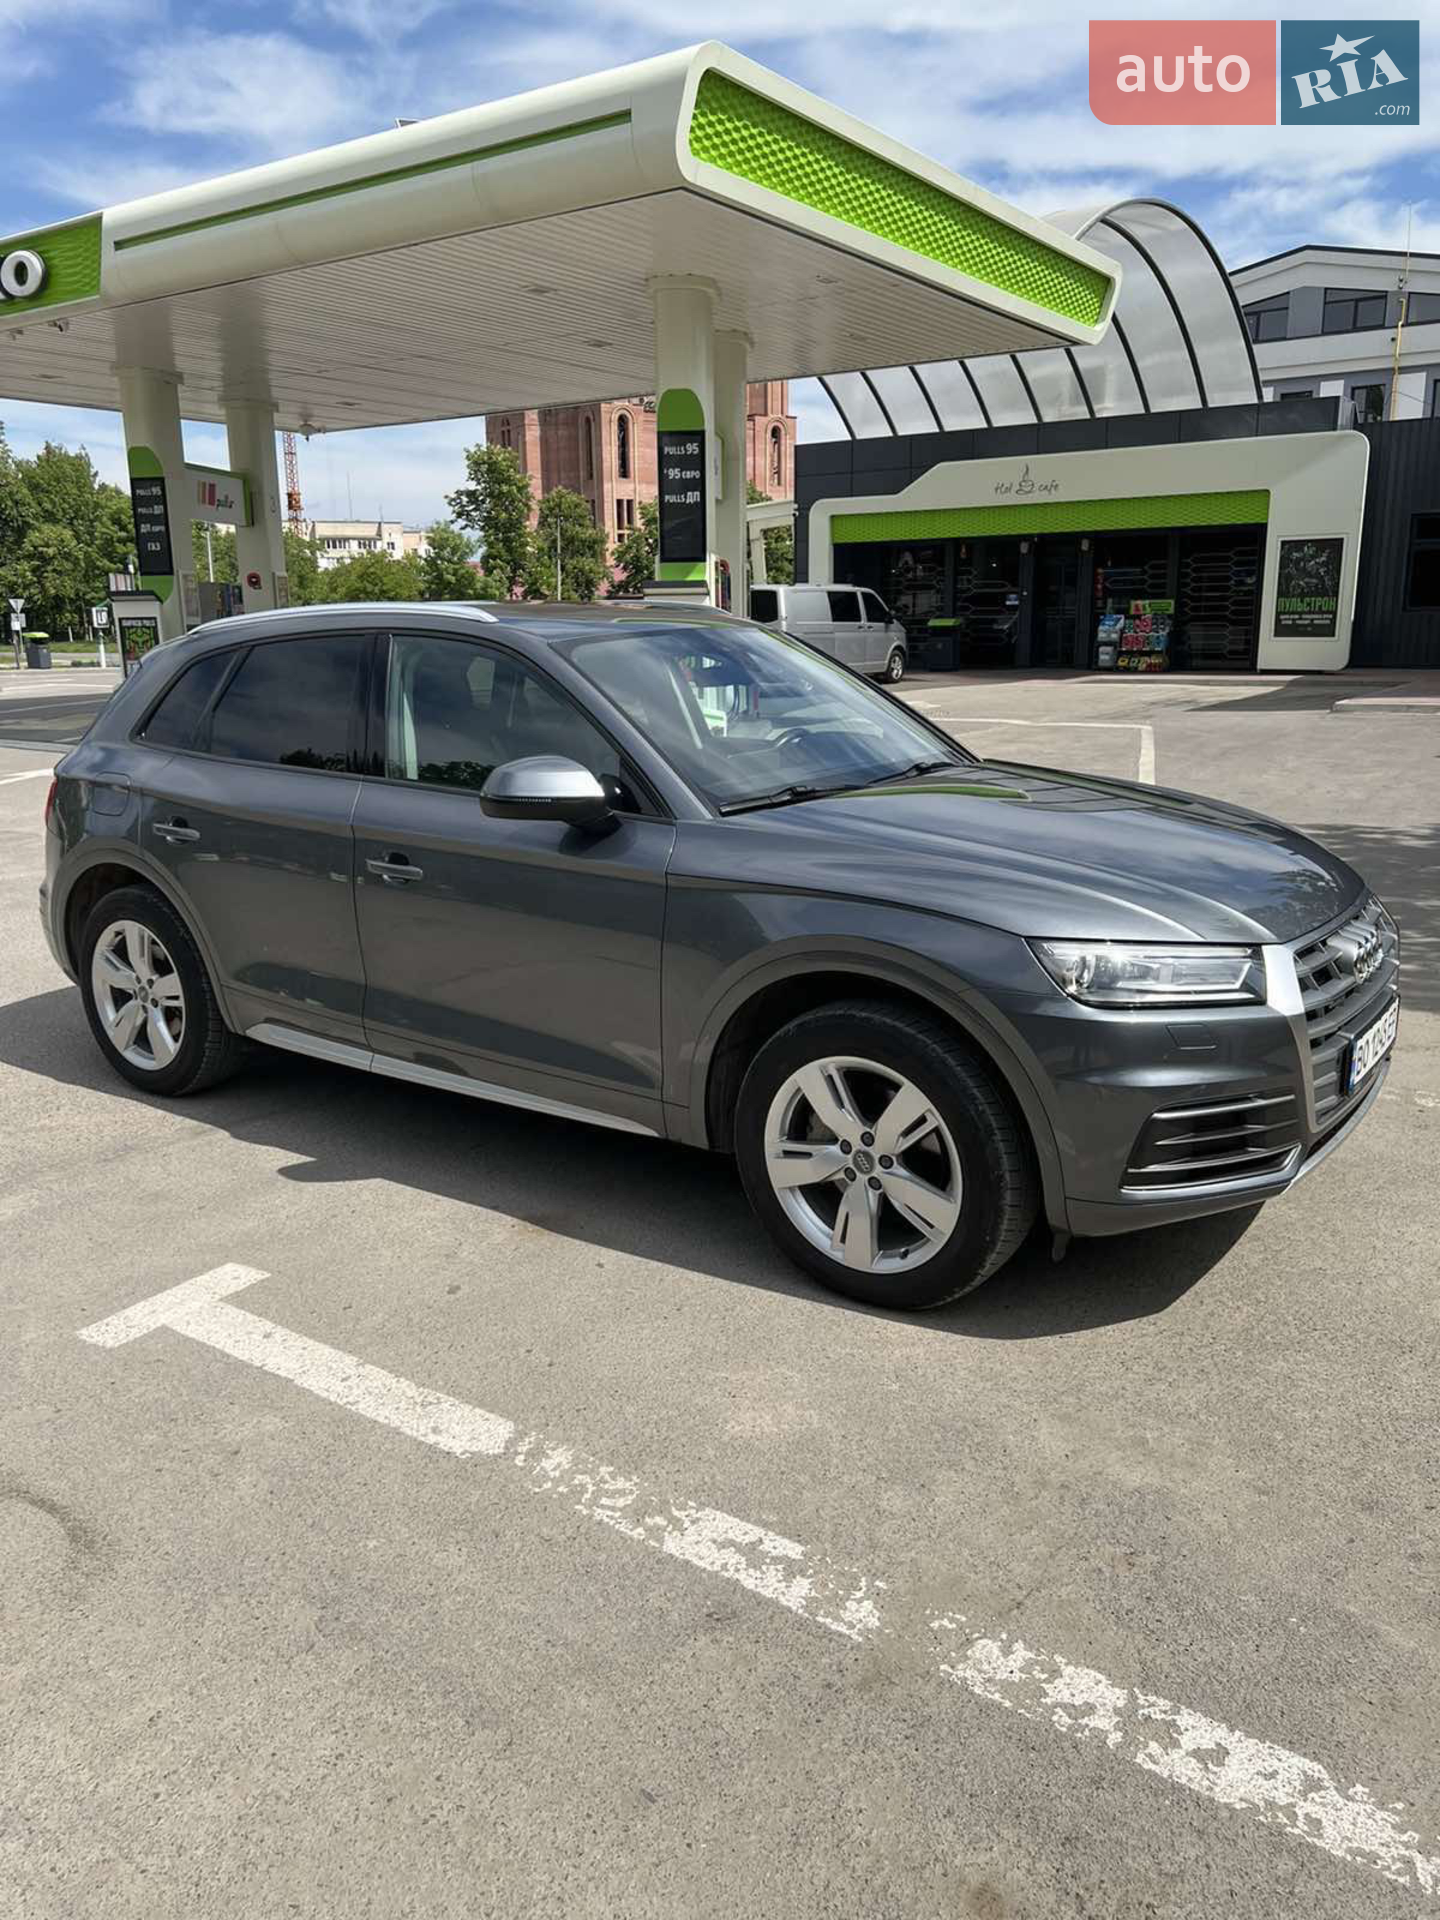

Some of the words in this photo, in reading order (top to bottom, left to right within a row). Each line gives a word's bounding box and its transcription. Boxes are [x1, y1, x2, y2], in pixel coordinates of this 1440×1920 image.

[664, 446, 685, 455] PULLS
[686, 443, 699, 455] 95
[664, 494, 685, 503] PULLS
[686, 491, 700, 504] ДП
[1277, 596, 1337, 613] ПУЛЬСТРОН
